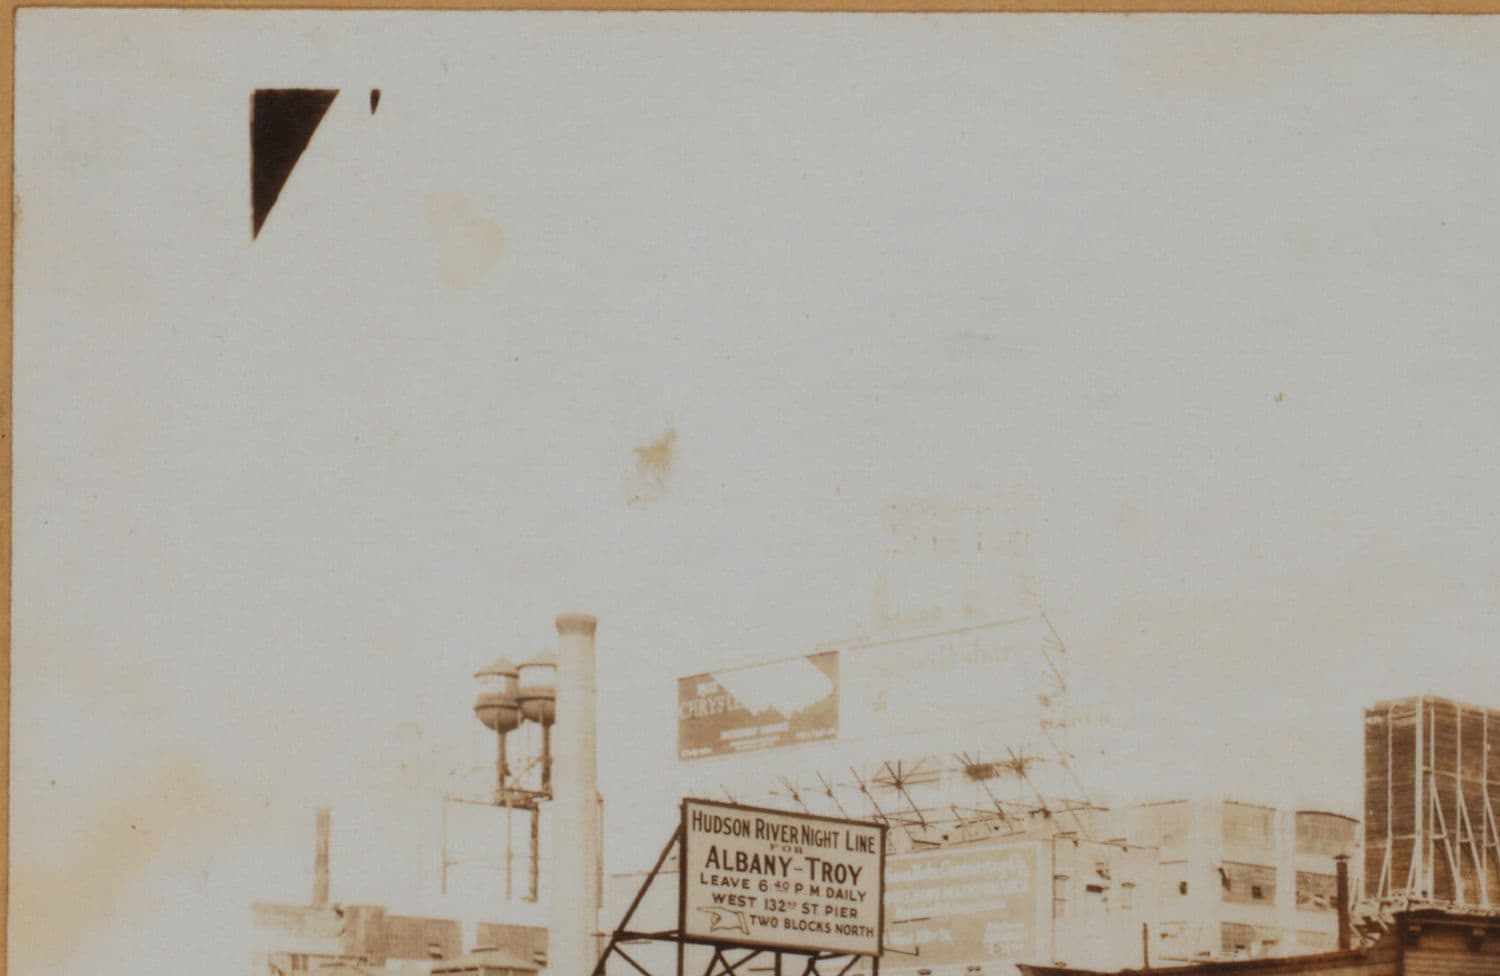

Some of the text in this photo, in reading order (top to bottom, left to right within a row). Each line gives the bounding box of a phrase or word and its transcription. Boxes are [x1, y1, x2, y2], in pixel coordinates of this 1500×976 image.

[692, 810, 875, 854] HUDSON RIVER NIGHT LINE
[769, 843, 803, 854] FOR
[700, 872, 750, 890] LEAVE
[826, 887, 867, 902] DAILY
[712, 892, 757, 907] WEST
[801, 902, 819, 915] ST
[825, 905, 858, 919] PIER
[750, 914, 779, 928] TWO
[784, 920, 831, 934] BLOCKS
[835, 925, 874, 938] NORTH
